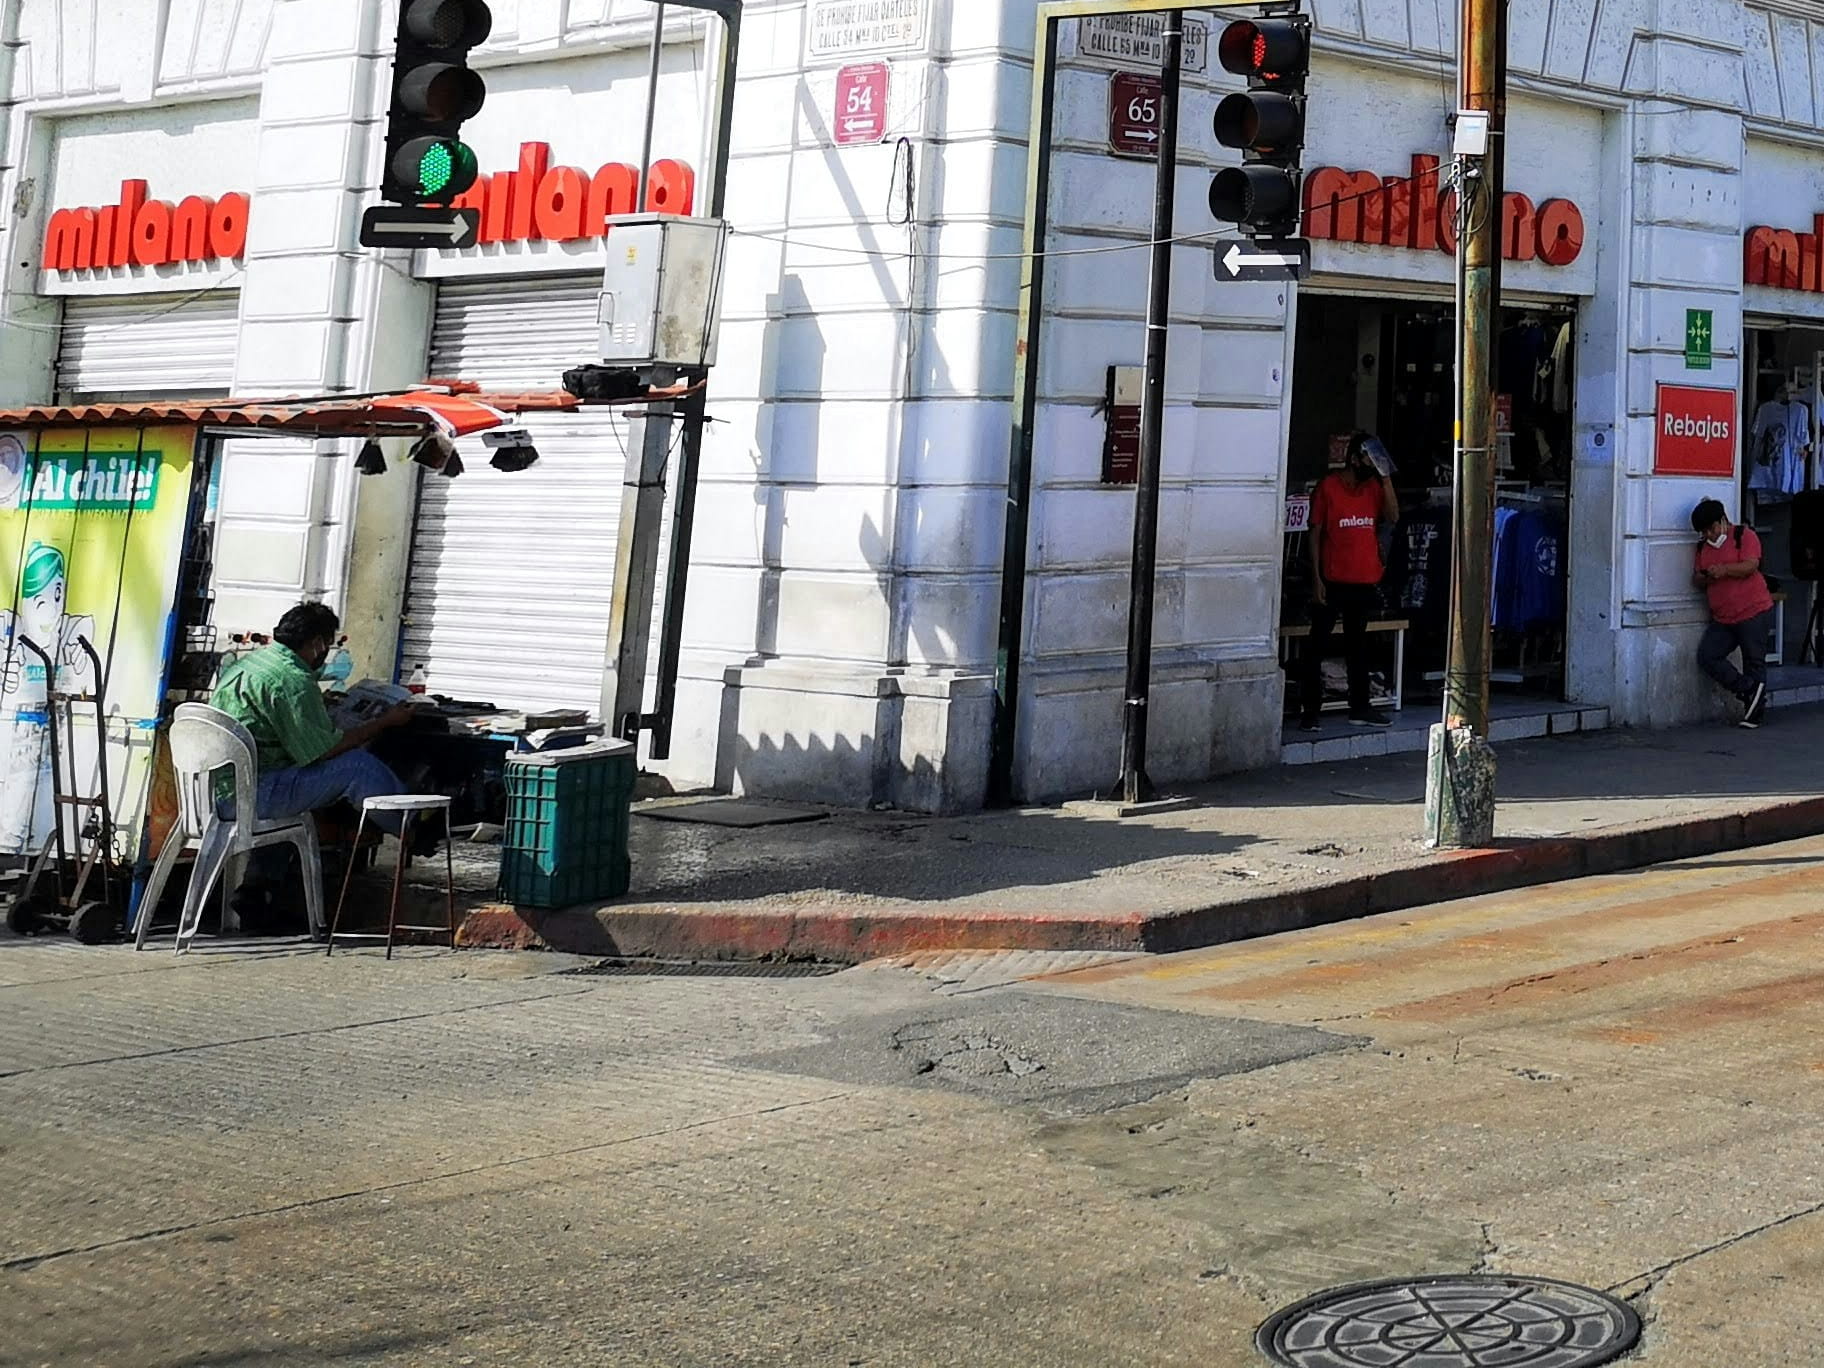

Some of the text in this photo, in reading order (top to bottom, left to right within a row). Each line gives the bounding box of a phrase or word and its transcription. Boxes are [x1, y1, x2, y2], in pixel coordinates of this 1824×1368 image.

[819, 31, 842, 48] CALLE
[1136, 16, 1160, 37] FIJAR
[1091, 33, 1119, 53] CALLE
[1120, 38, 1131, 55] 65
[846, 85, 873, 114] 54
[1128, 97, 1156, 123] 65
[43, 178, 250, 270] milano
[1664, 412, 1729, 443] Rebajas
